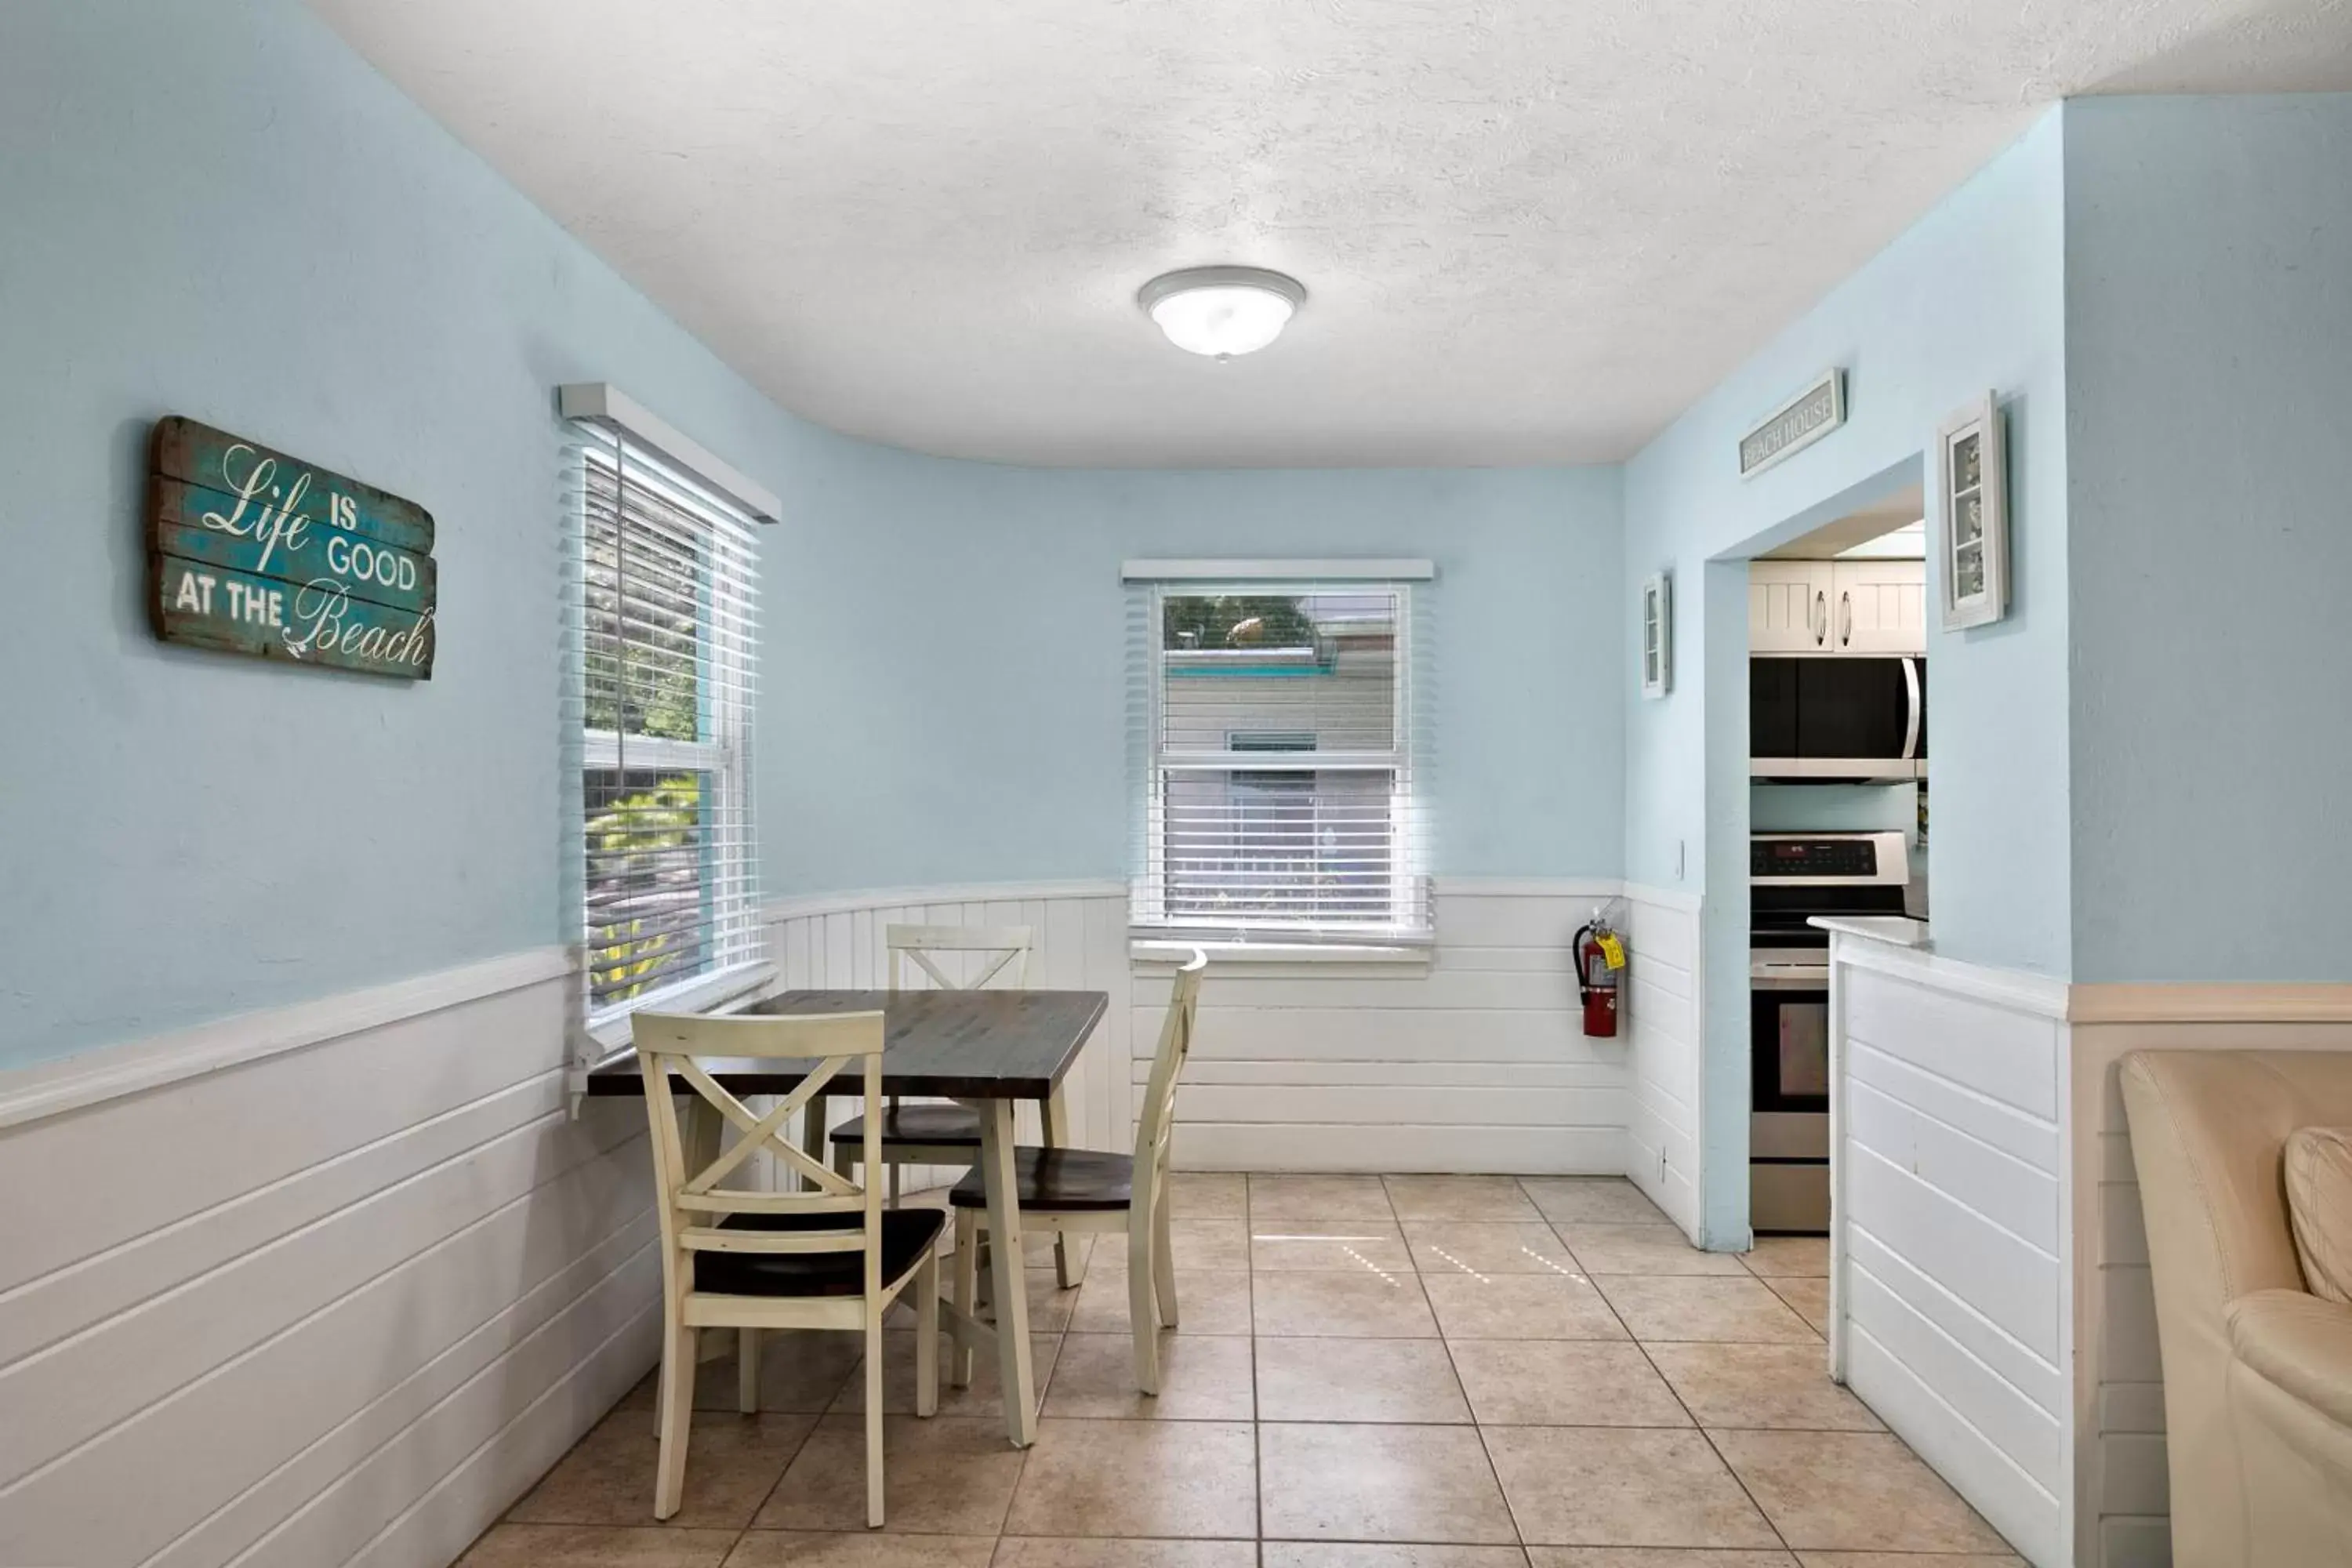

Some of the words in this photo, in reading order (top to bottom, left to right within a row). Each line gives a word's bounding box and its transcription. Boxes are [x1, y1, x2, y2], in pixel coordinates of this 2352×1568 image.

[1744, 426, 1782, 470] BEACH
[1784, 395, 1831, 444] HOUSE
[201, 443, 311, 572] Life
[329, 492, 357, 532] IS
[327, 535, 416, 591] GOOD
[176, 572, 216, 615] AT
[226, 580, 283, 628] THE
[281, 578, 435, 666] Beach
